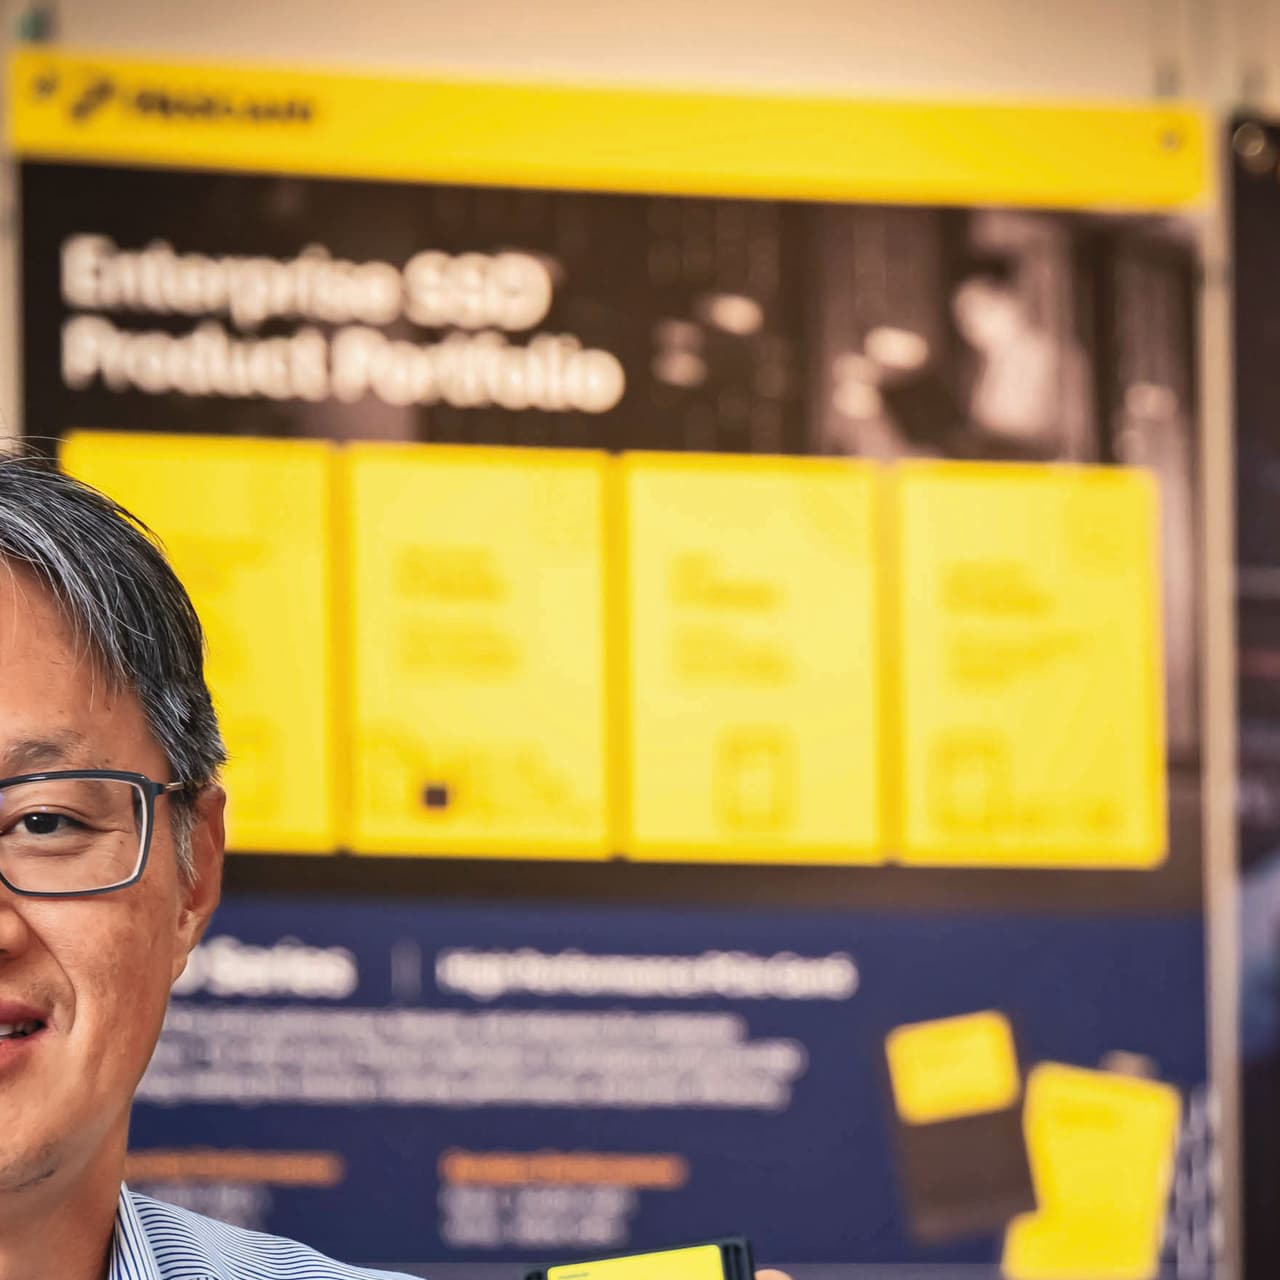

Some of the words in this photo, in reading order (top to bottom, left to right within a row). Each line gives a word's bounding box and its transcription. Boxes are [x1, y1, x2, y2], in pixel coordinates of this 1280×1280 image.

[62, 234, 402, 331] Enterprise
[404, 249, 552, 331] SSD
[61, 315, 328, 400] Product
[330, 326, 625, 413] Portfolio
